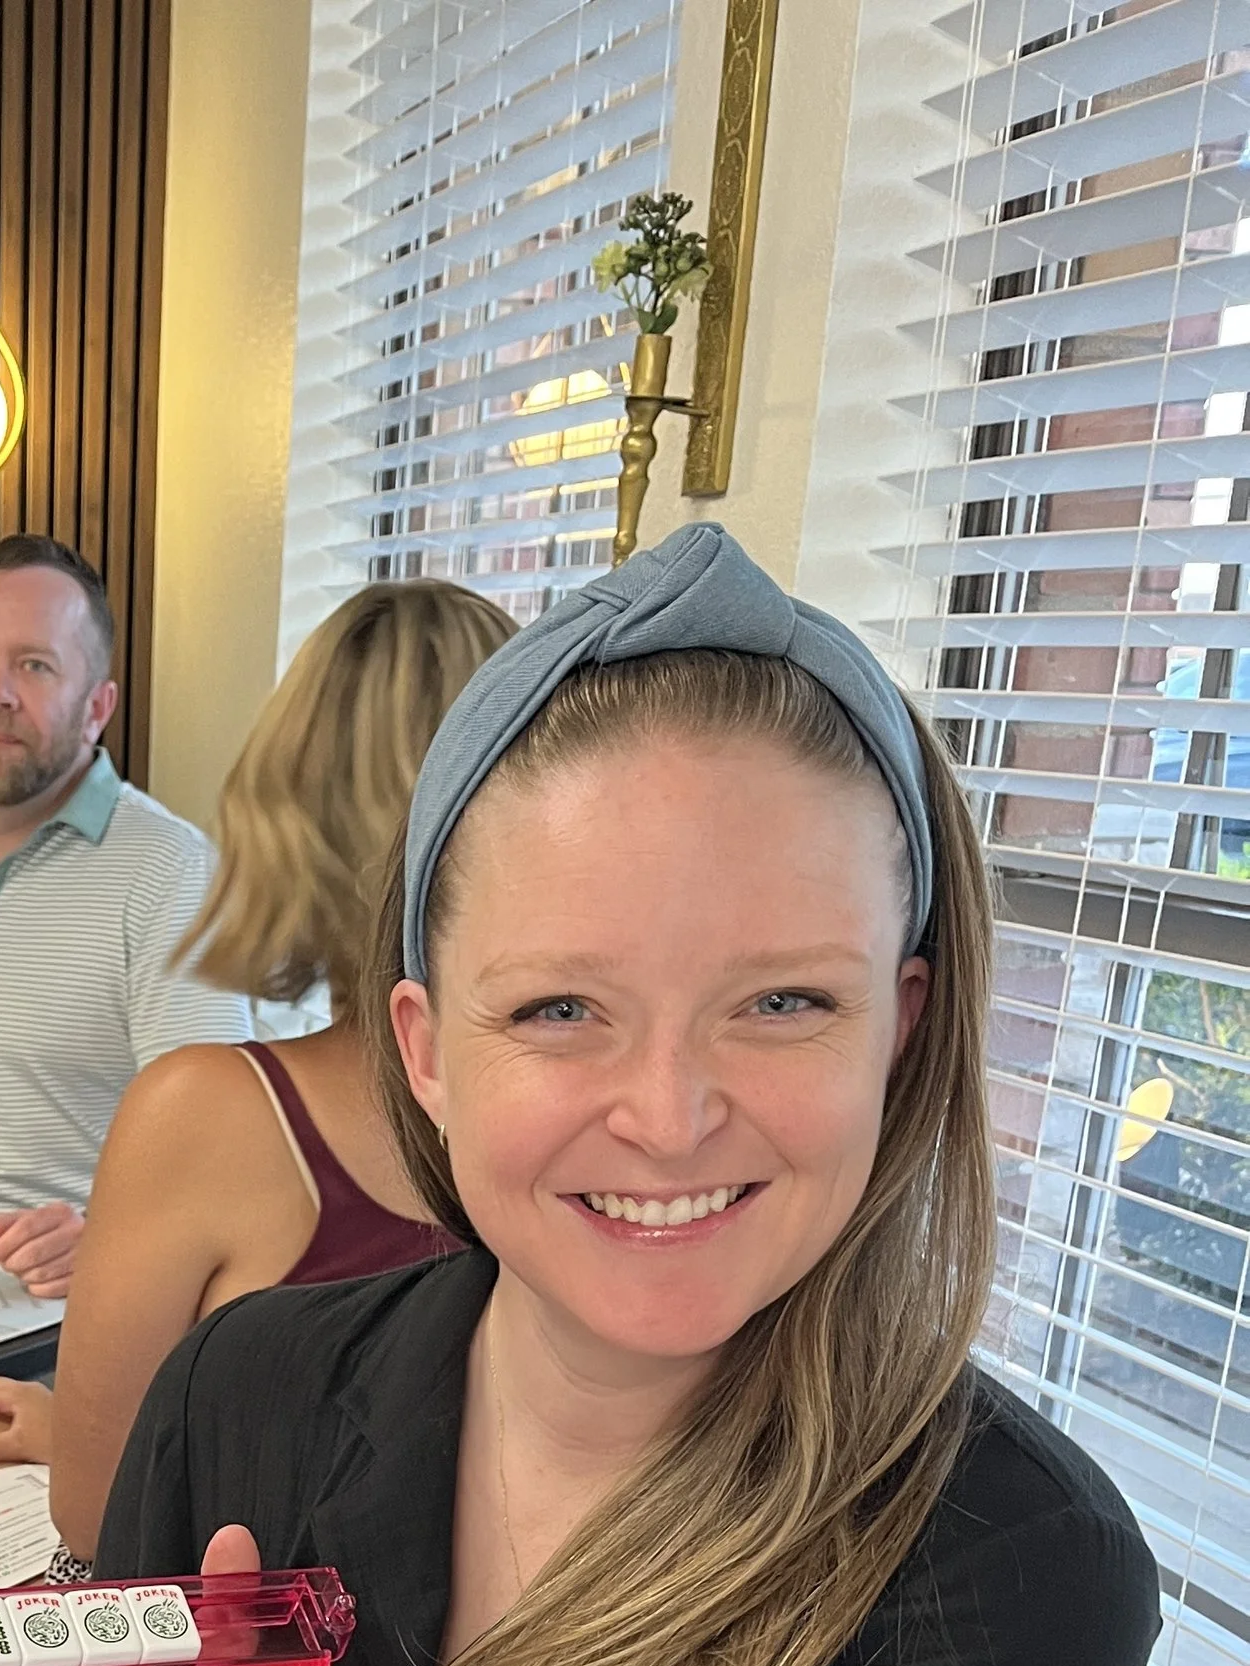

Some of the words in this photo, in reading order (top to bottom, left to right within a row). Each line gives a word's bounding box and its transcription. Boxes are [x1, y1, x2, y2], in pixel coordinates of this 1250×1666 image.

[77, 1592, 121, 1605] JOKER
[135, 1588, 179, 1601] JOKER
[16, 1598, 61, 1611] JOKER
